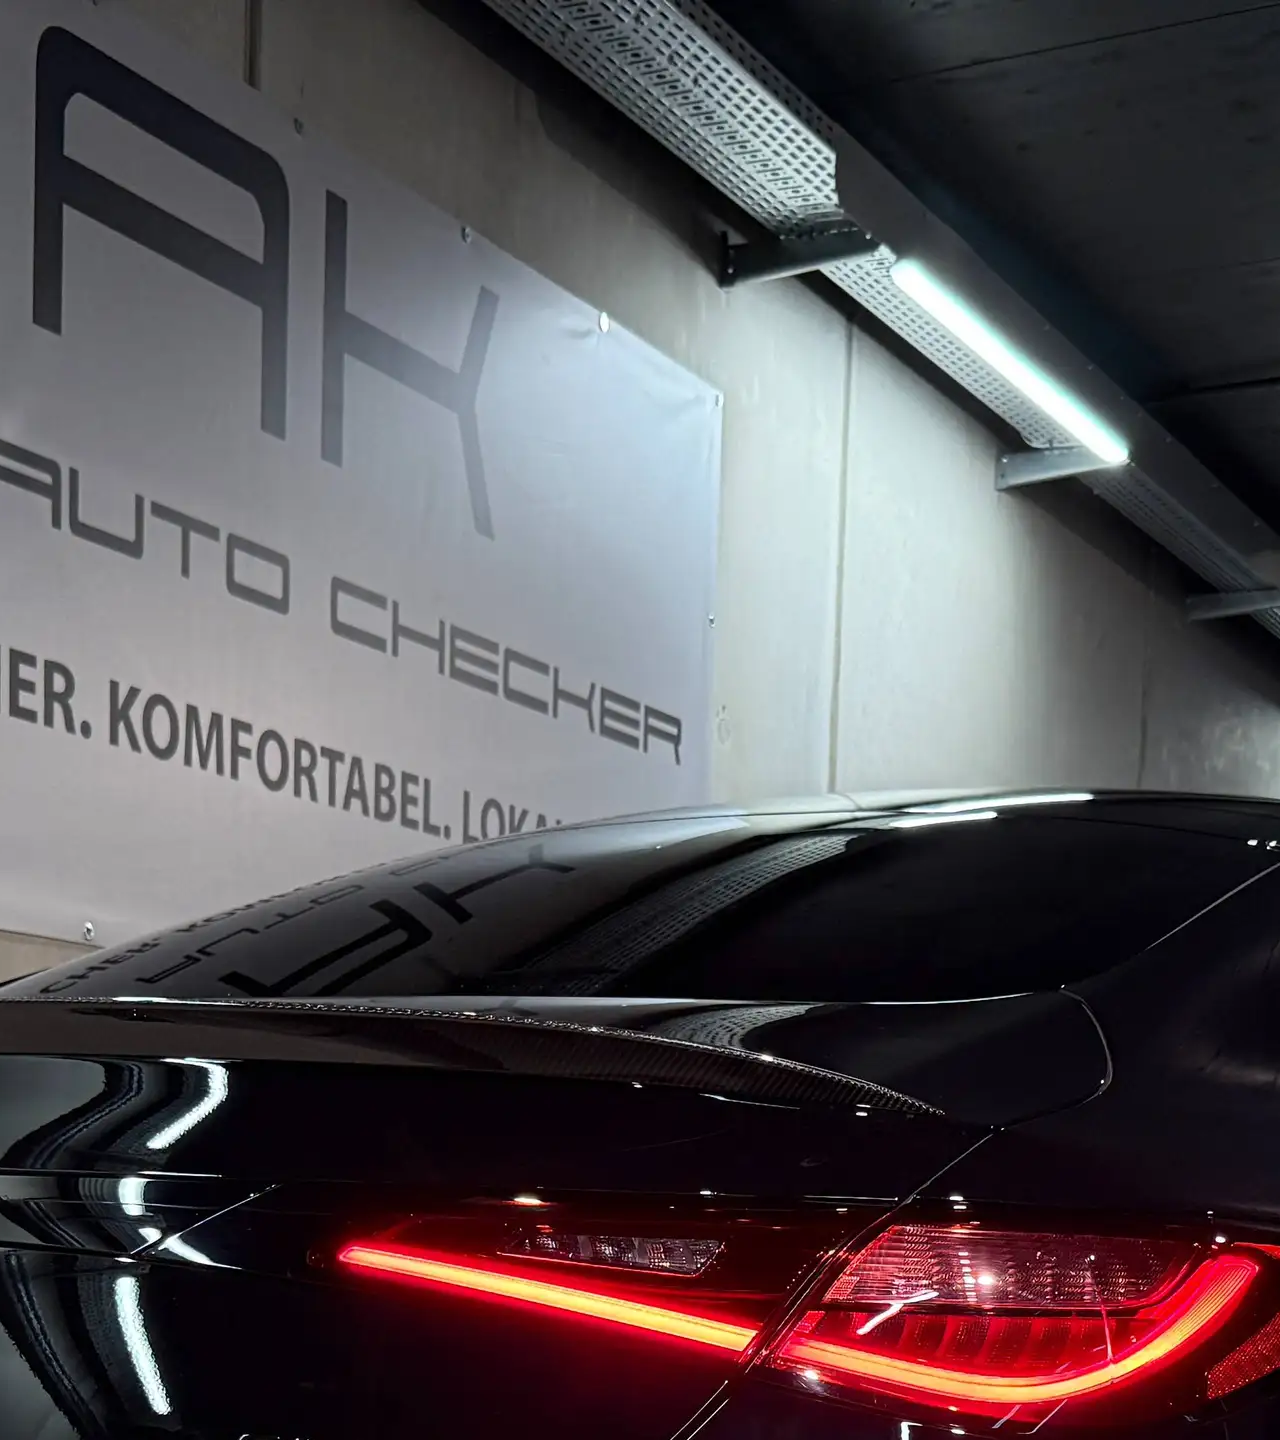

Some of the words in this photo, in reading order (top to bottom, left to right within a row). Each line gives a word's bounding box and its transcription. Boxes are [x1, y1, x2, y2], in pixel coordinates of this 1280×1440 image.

[32, 25, 500, 541] AK
[109, 679, 452, 841] KOMFORTABEL.
[330, 575, 684, 767] CHECKER
